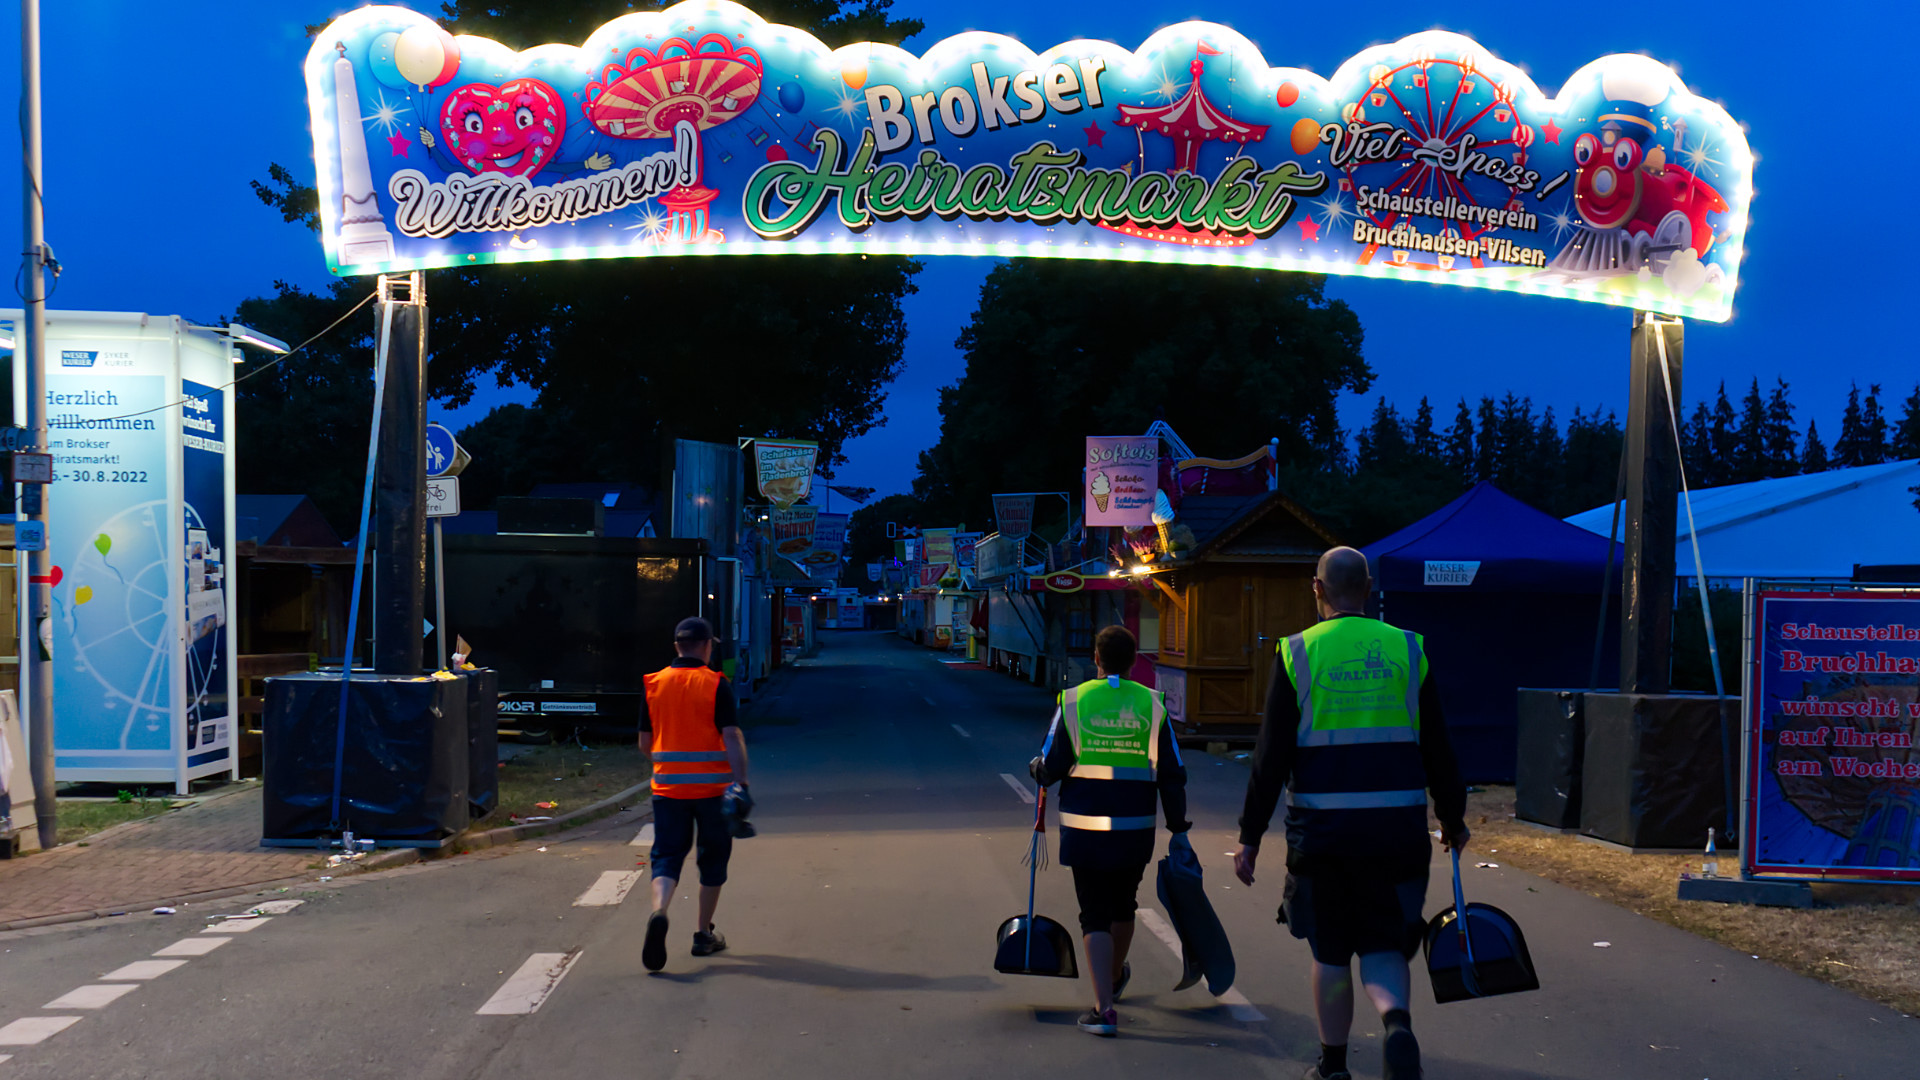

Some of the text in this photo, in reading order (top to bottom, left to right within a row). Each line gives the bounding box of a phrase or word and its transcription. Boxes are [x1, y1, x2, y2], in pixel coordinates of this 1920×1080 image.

[864, 53, 1105, 152] Brokser
[1320, 122, 1405, 167] Viel
[391, 120, 697, 237] Willkommen!
[743, 127, 1325, 238] Heiratsmarkt
[1356, 184, 1538, 231] Schaustellerverein
[1352, 219, 1546, 267] Bruchhausen-Vilsen
[66, 438, 110, 449] Brokser
[1089, 443, 1156, 464] Softeis
[52, 454, 120, 465] eiratsmarkt!
[760, 448, 814, 460] Schafskäse
[760, 463, 773, 471] im
[760, 469, 811, 482] Fladenbrot
[774, 519, 815, 541] Bratwurst
[1428, 563, 1465, 572] WESER
[1428, 573, 1469, 583] KURIER
[1328, 669, 1393, 682] WALTER
[1781, 696, 1899, 717] wünscht
[1090, 718, 1142, 729] WALTER
[1779, 727, 1912, 747] auf Ihren
[1778, 757, 1920, 778] am Woche
